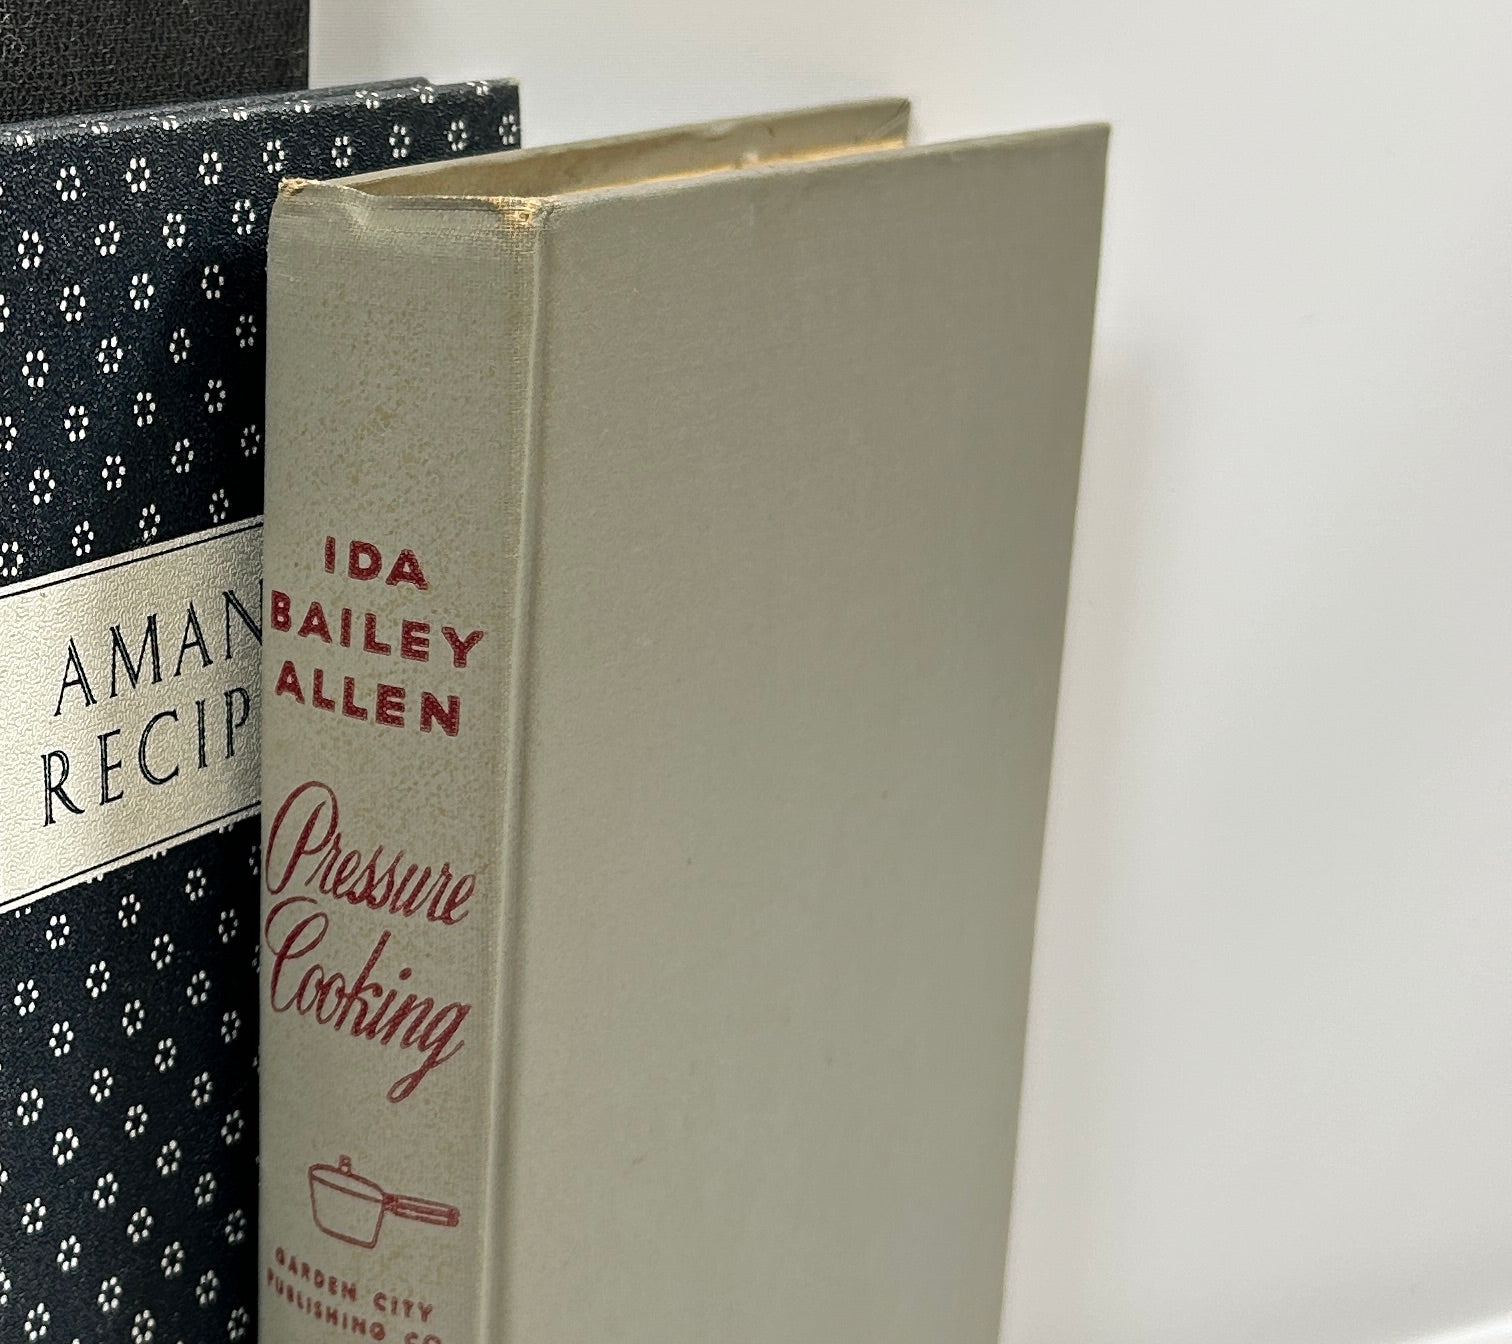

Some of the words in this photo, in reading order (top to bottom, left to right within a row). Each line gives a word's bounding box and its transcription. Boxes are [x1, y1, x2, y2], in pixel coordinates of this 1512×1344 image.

[325, 536, 429, 590] IDA
[271, 590, 484, 668] BAILEY
[274, 660, 461, 737] ALLEN
[40, 687, 250, 827] RECIP
[265, 780, 477, 925] Pressure
[265, 896, 472, 1103] Cooking
[267, 1267, 386, 1341] PUBLISHING
[275, 1247, 357, 1302] GARDEN
[373, 1292, 433, 1323] CITY
